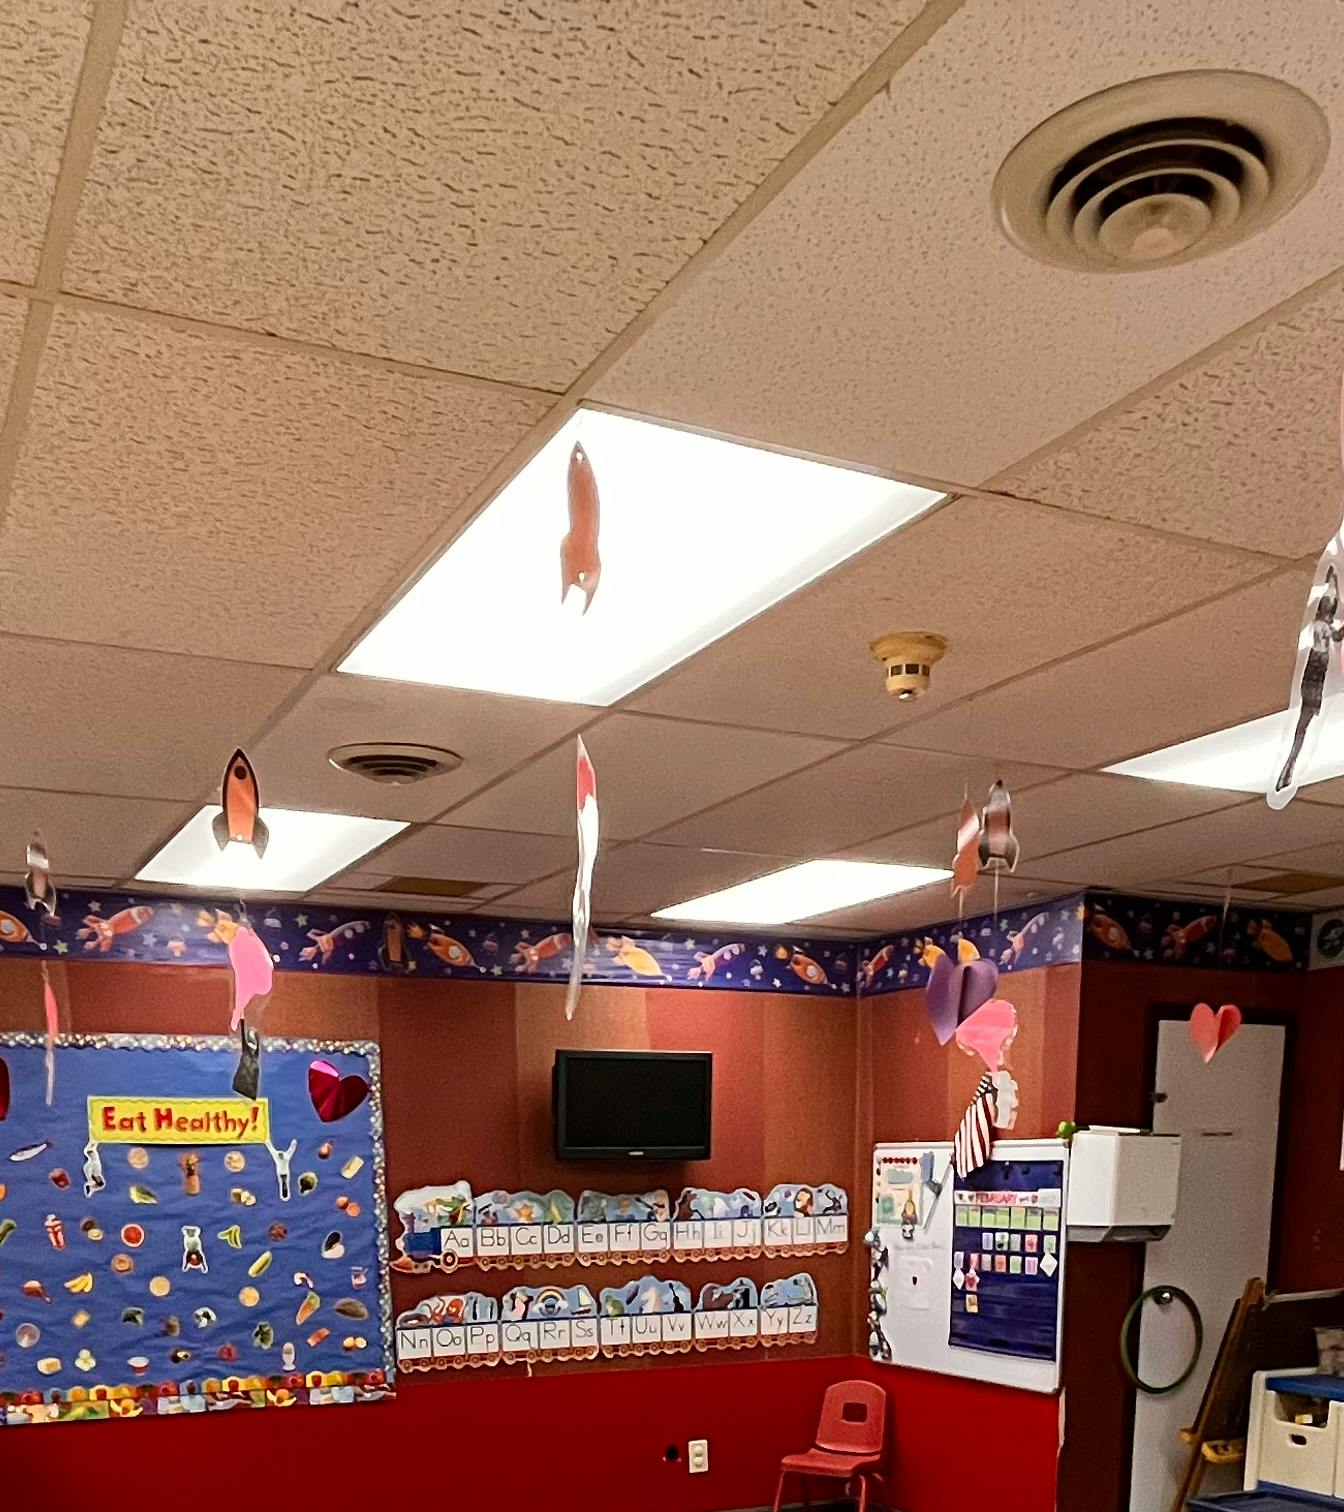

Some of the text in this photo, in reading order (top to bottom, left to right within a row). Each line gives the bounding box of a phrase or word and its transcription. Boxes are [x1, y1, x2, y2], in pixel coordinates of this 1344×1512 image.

[102, 1106, 259, 1140] Eat Healthy!
[444, 1218, 845, 1248] Aa Bb Cc Dd Ee Ff Gg Hh Ii Jj Kk Ll Mm
[401, 1307, 812, 1350] Nn Oo Pp Qq Rr Ss Tt Uu Vv Ww Xx Yy Zz
